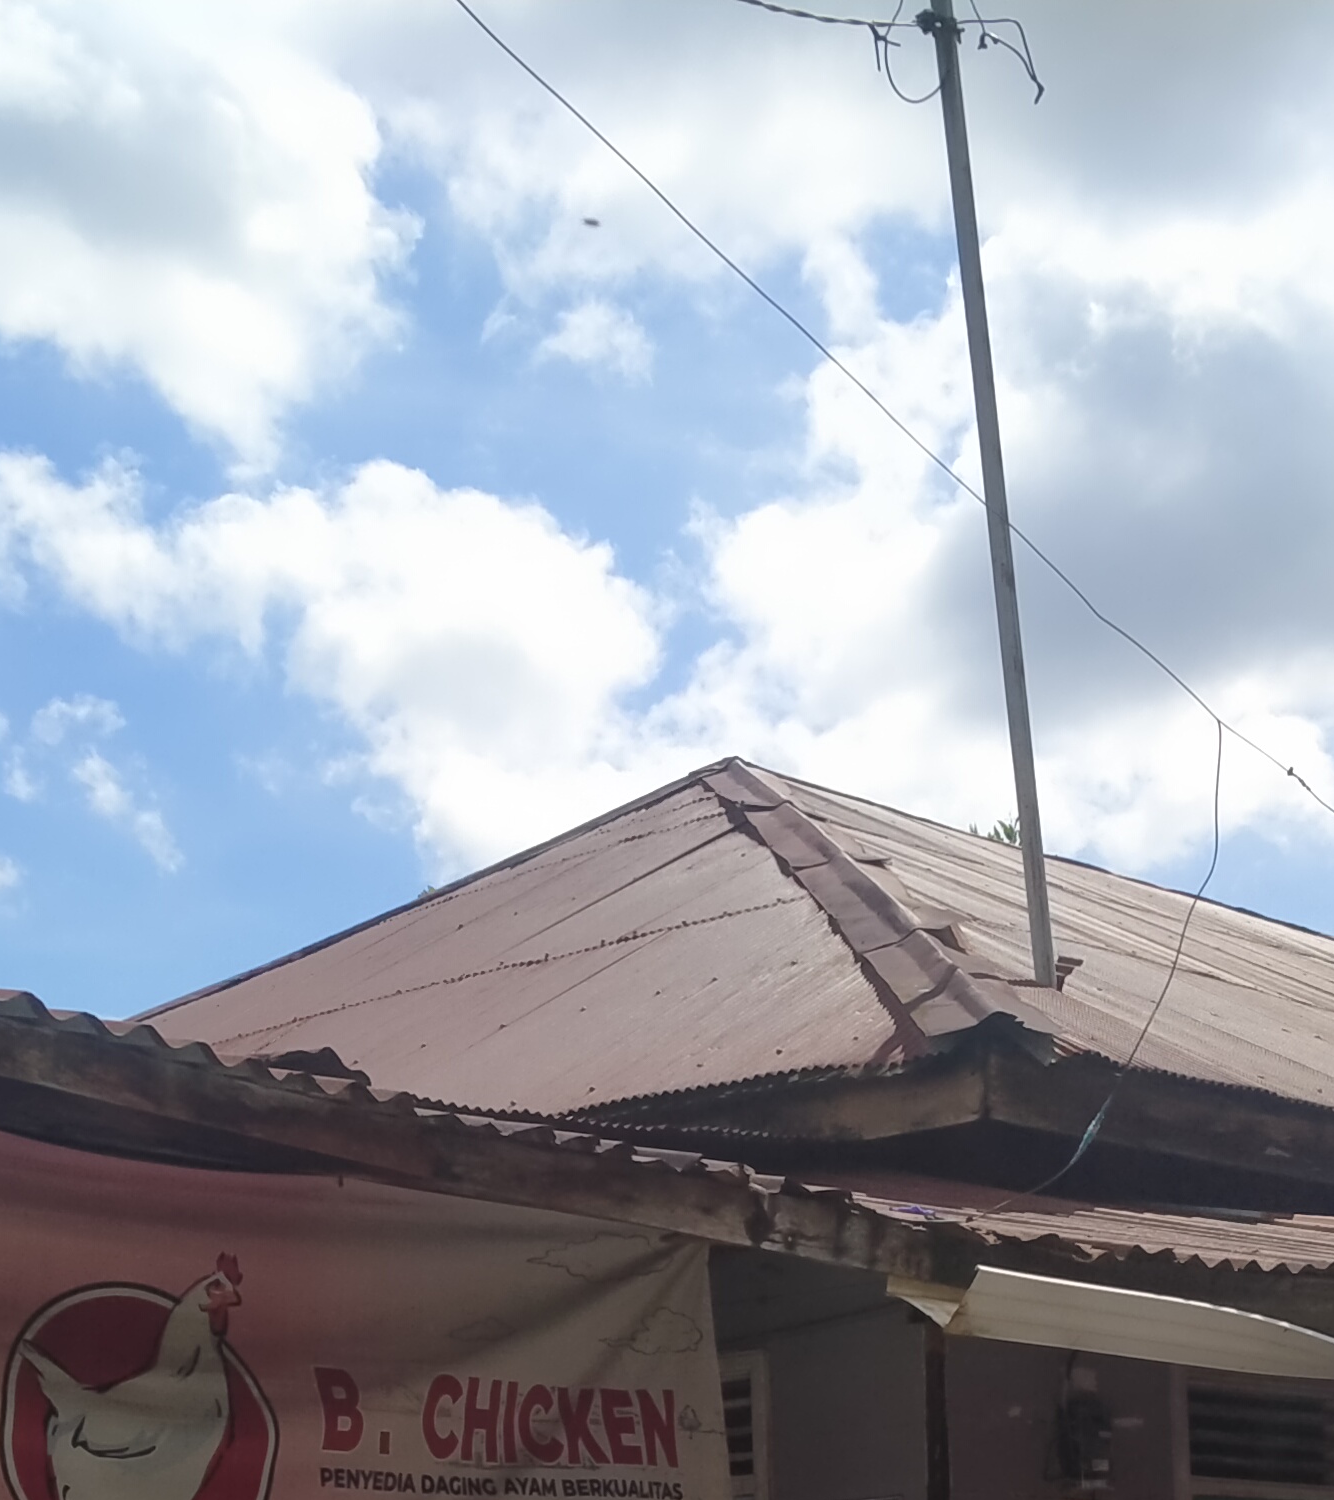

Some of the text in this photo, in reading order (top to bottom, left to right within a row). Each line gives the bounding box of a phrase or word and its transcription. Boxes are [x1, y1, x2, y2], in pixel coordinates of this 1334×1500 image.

[420, 1372, 680, 1469] CHICKEN
[320, 1467, 416, 1493] PENYEDIA
[421, 1473, 497, 1497] DAGING
[503, 1476, 558, 1499] AYAM
